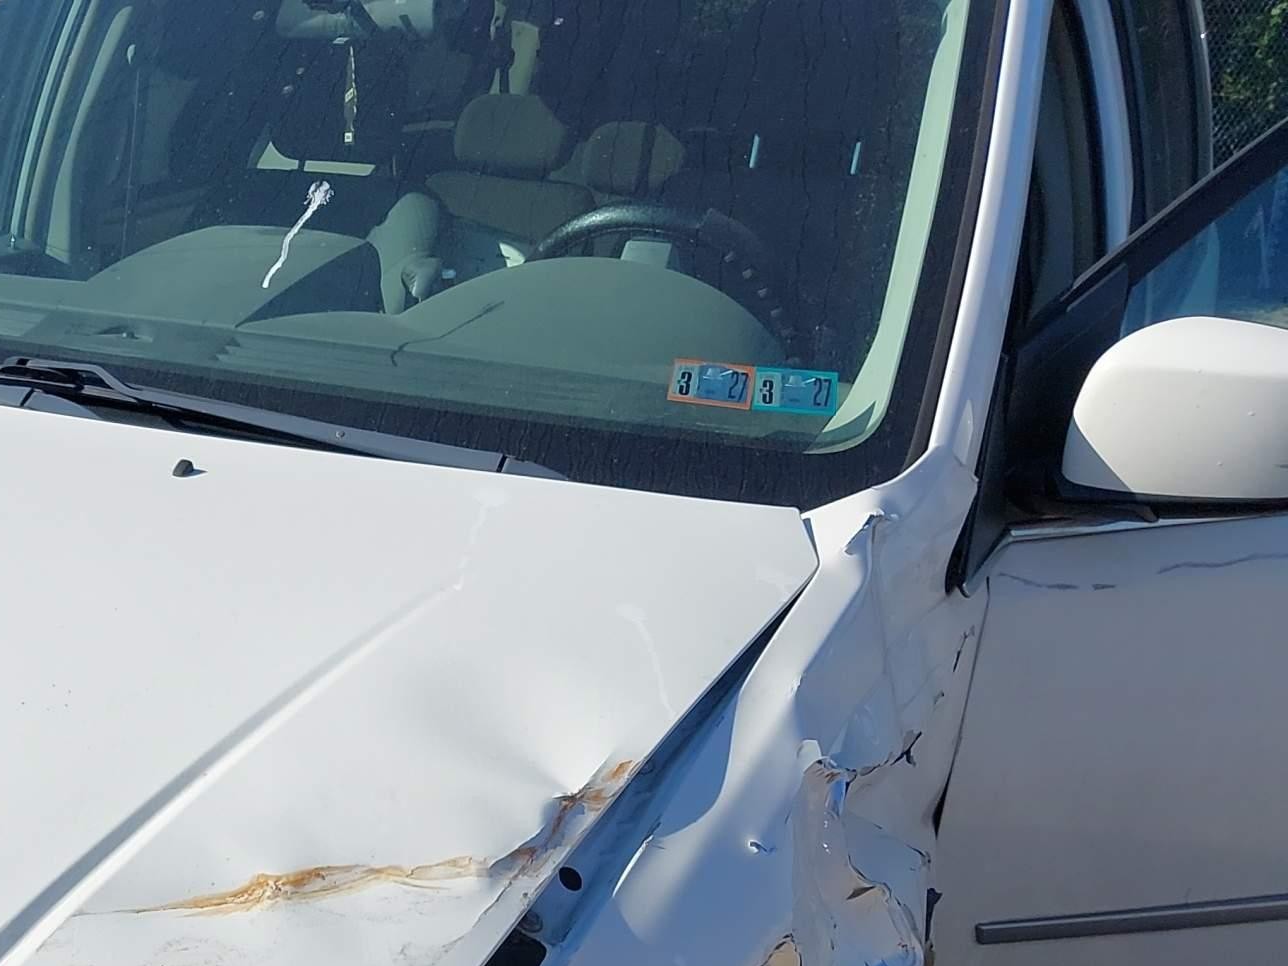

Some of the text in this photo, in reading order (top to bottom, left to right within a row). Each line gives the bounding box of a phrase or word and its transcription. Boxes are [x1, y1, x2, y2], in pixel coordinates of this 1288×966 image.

[678, 371, 749, 403] 3 27
[762, 377, 832, 407] 3 27
